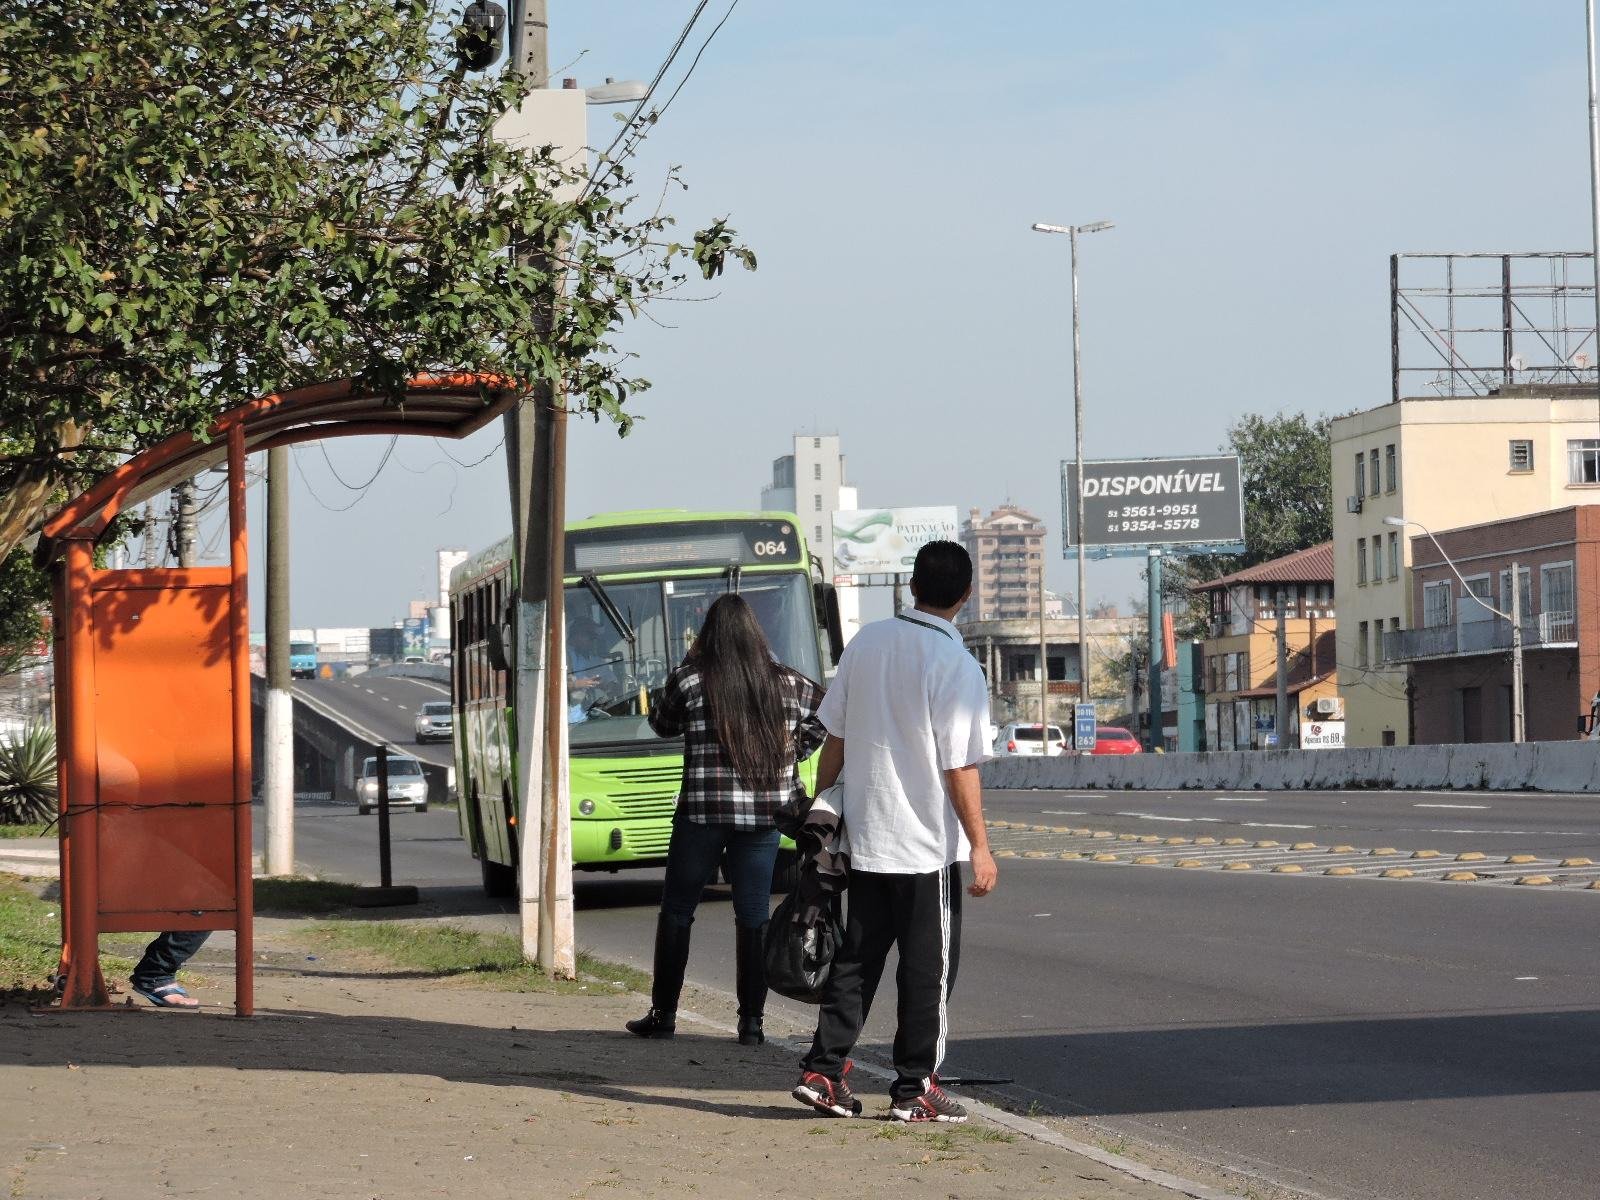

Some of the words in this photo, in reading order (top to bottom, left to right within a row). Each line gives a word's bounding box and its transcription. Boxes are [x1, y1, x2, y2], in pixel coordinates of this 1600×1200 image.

[1083, 469, 1225, 498] DISPONÍVEL
[1107, 510, 1118, 518] 51
[1121, 504, 1198, 518] 3561-9951
[896, 522, 955, 534] PATINAÇÃO
[1107, 524, 1119, 533] 51
[1122, 518, 1200, 532] 9354-5578
[754, 540, 787, 556] 064
[1078, 736, 1094, 746] 263
